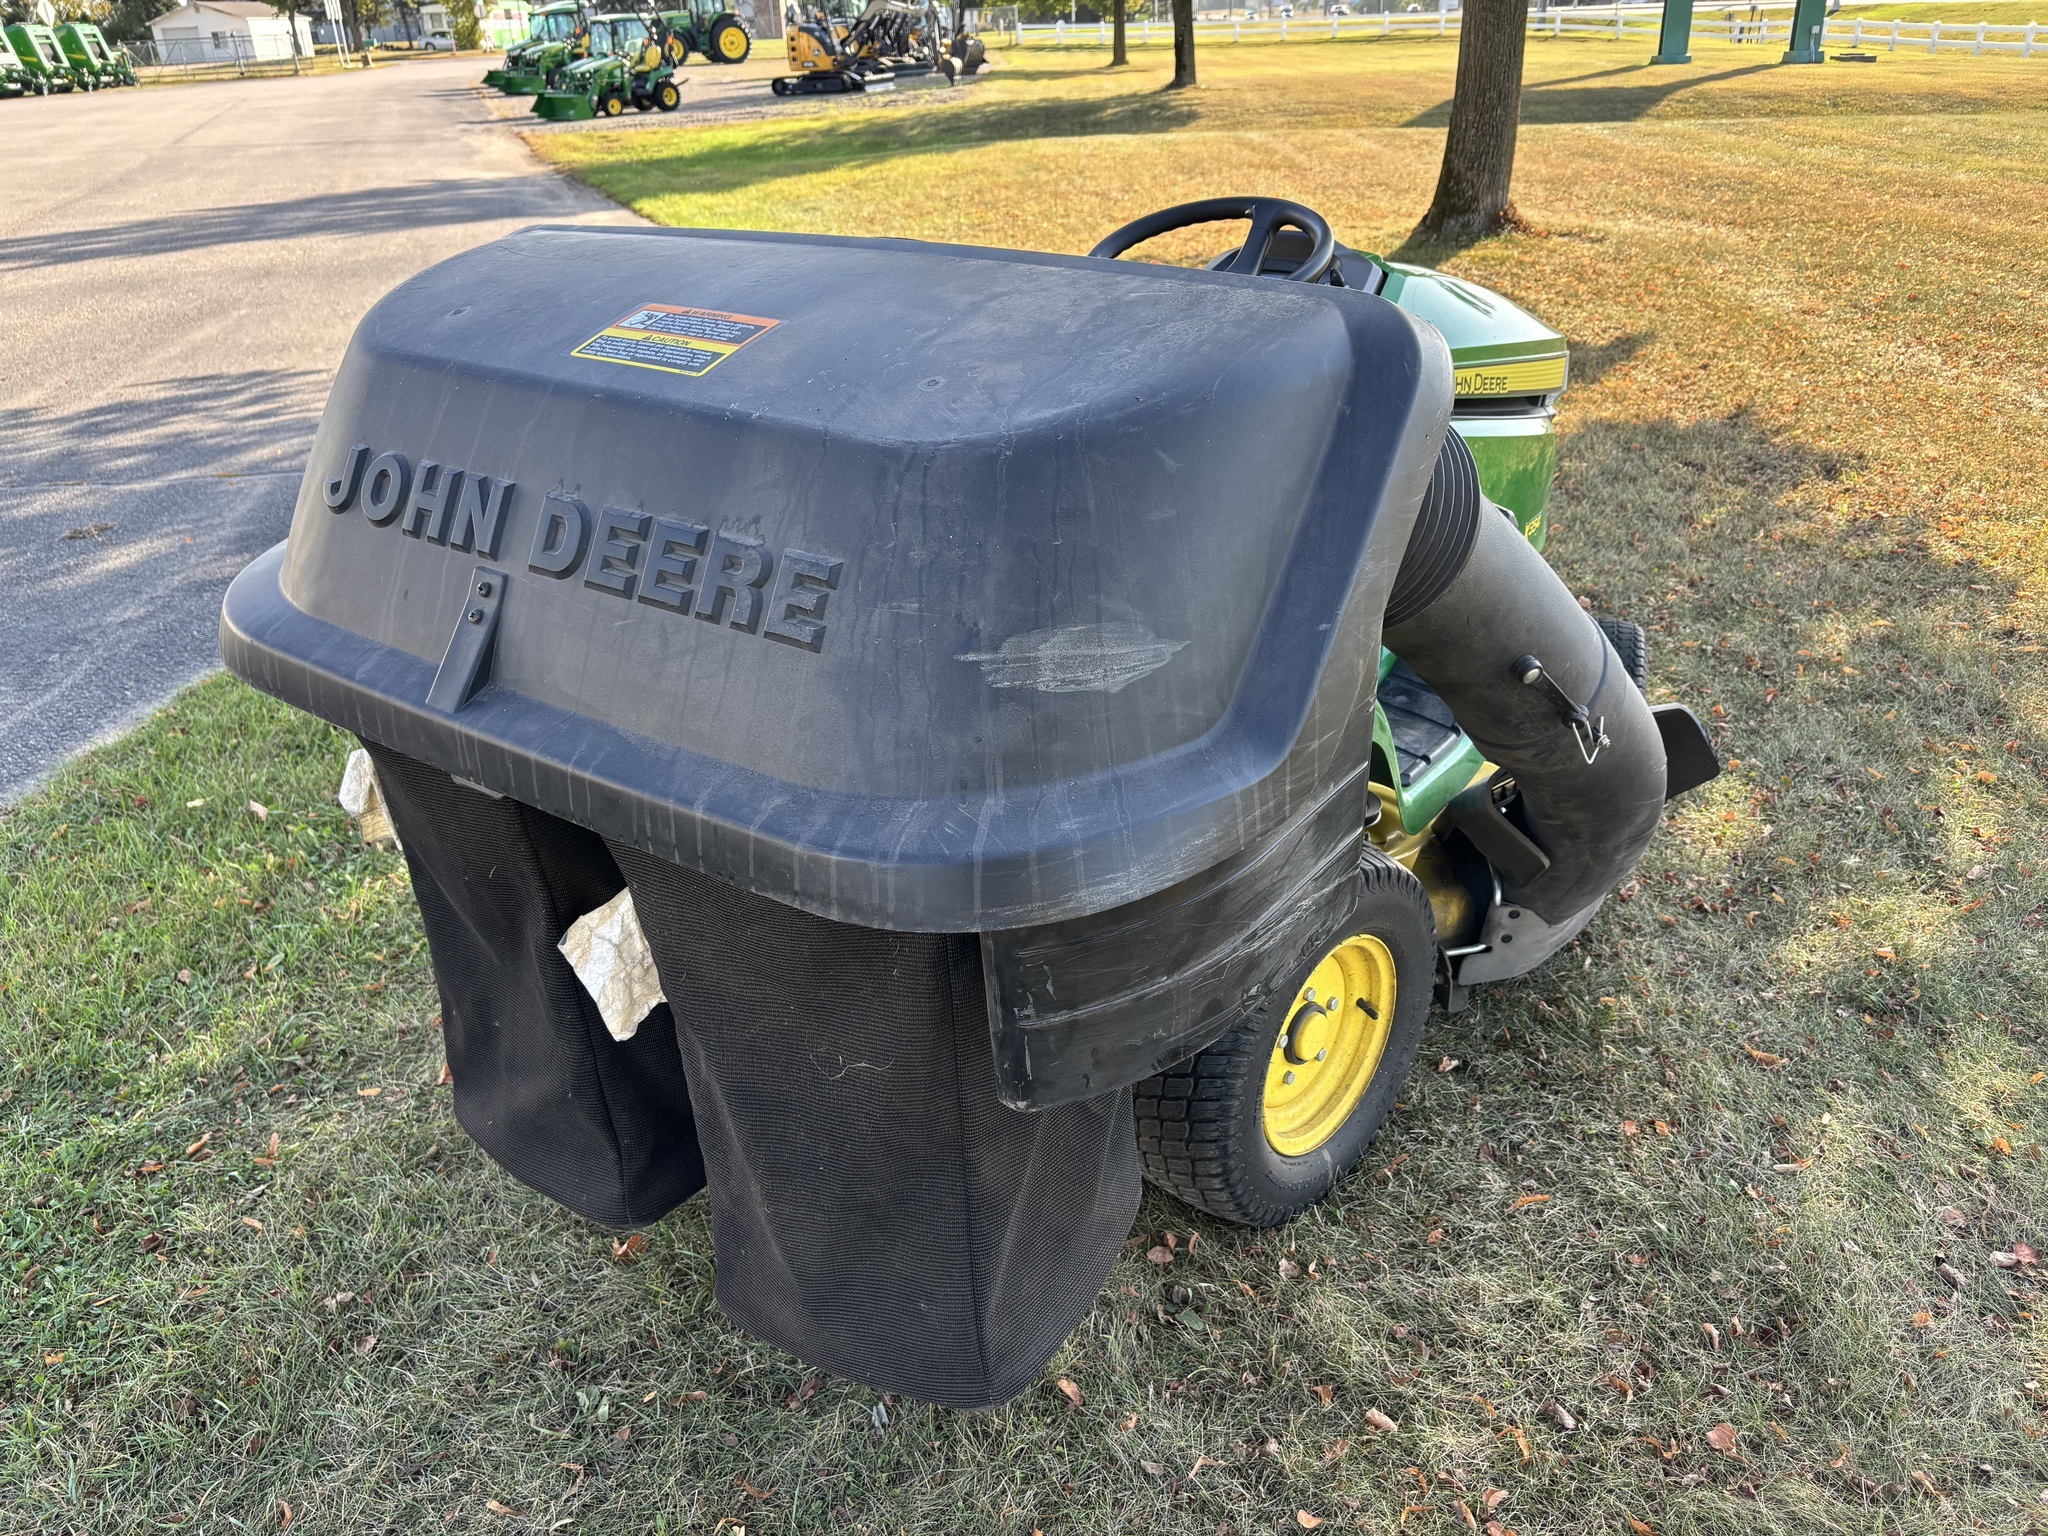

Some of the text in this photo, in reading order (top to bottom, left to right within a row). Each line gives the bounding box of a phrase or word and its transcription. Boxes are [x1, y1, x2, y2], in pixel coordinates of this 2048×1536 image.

[690, 310, 733, 319] WARNING
[651, 336, 692, 345] CAUTION
[1455, 373, 1508, 392] HN DEERE
[323, 444, 844, 654] JOHN DEERE
